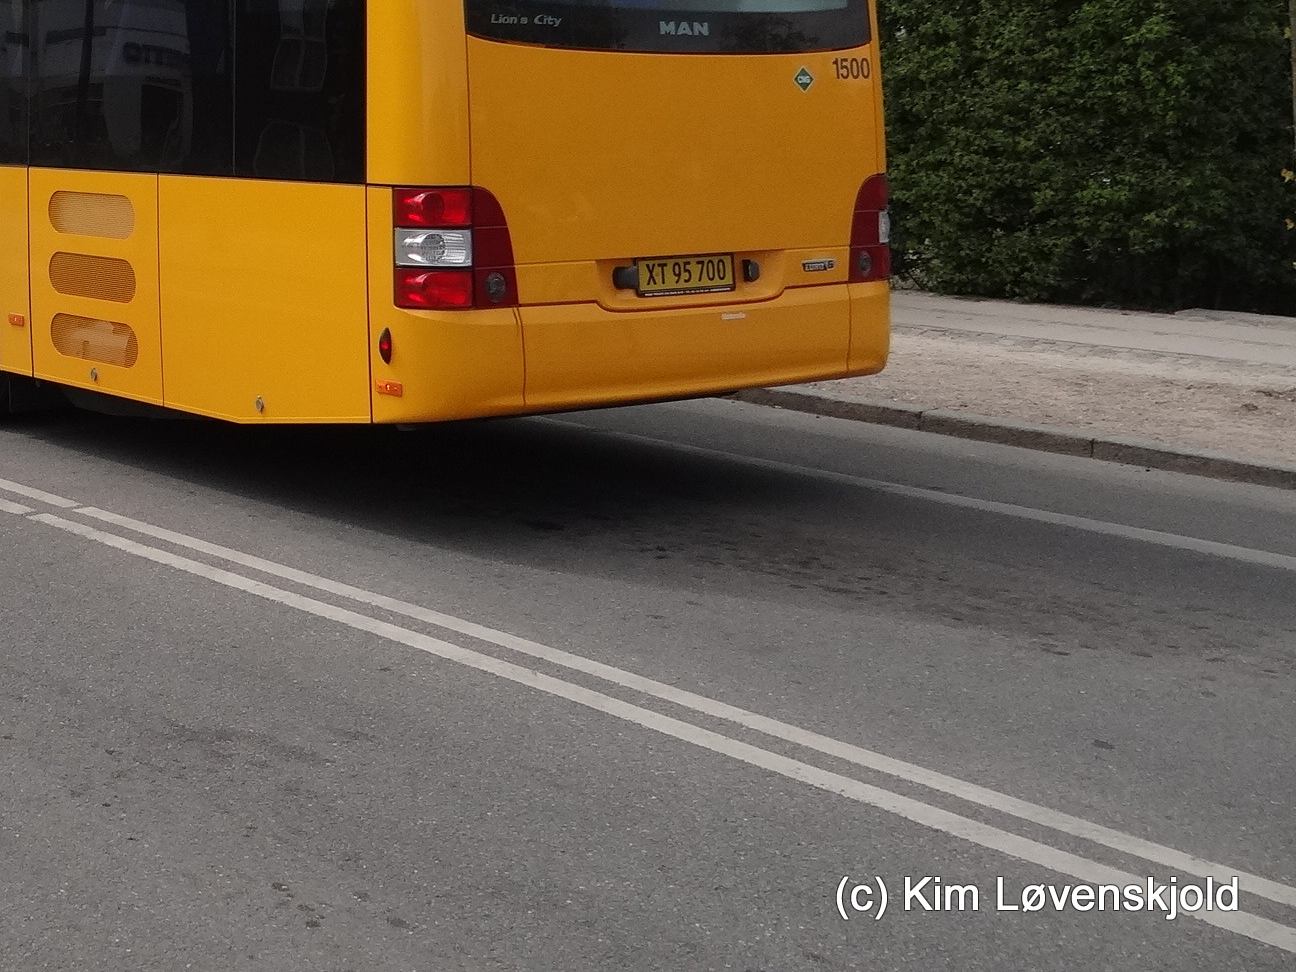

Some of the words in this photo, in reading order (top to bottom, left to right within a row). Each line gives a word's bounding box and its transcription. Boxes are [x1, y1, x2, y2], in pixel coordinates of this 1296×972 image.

[490, 13, 529, 25] Lion's
[533, 13, 562, 27] City
[659, 21, 709, 36] MAN
[832, 57, 871, 80] 1500
[646, 263, 667, 285] XT
[672, 261, 692, 284] 95
[696, 259, 726, 282] 700
